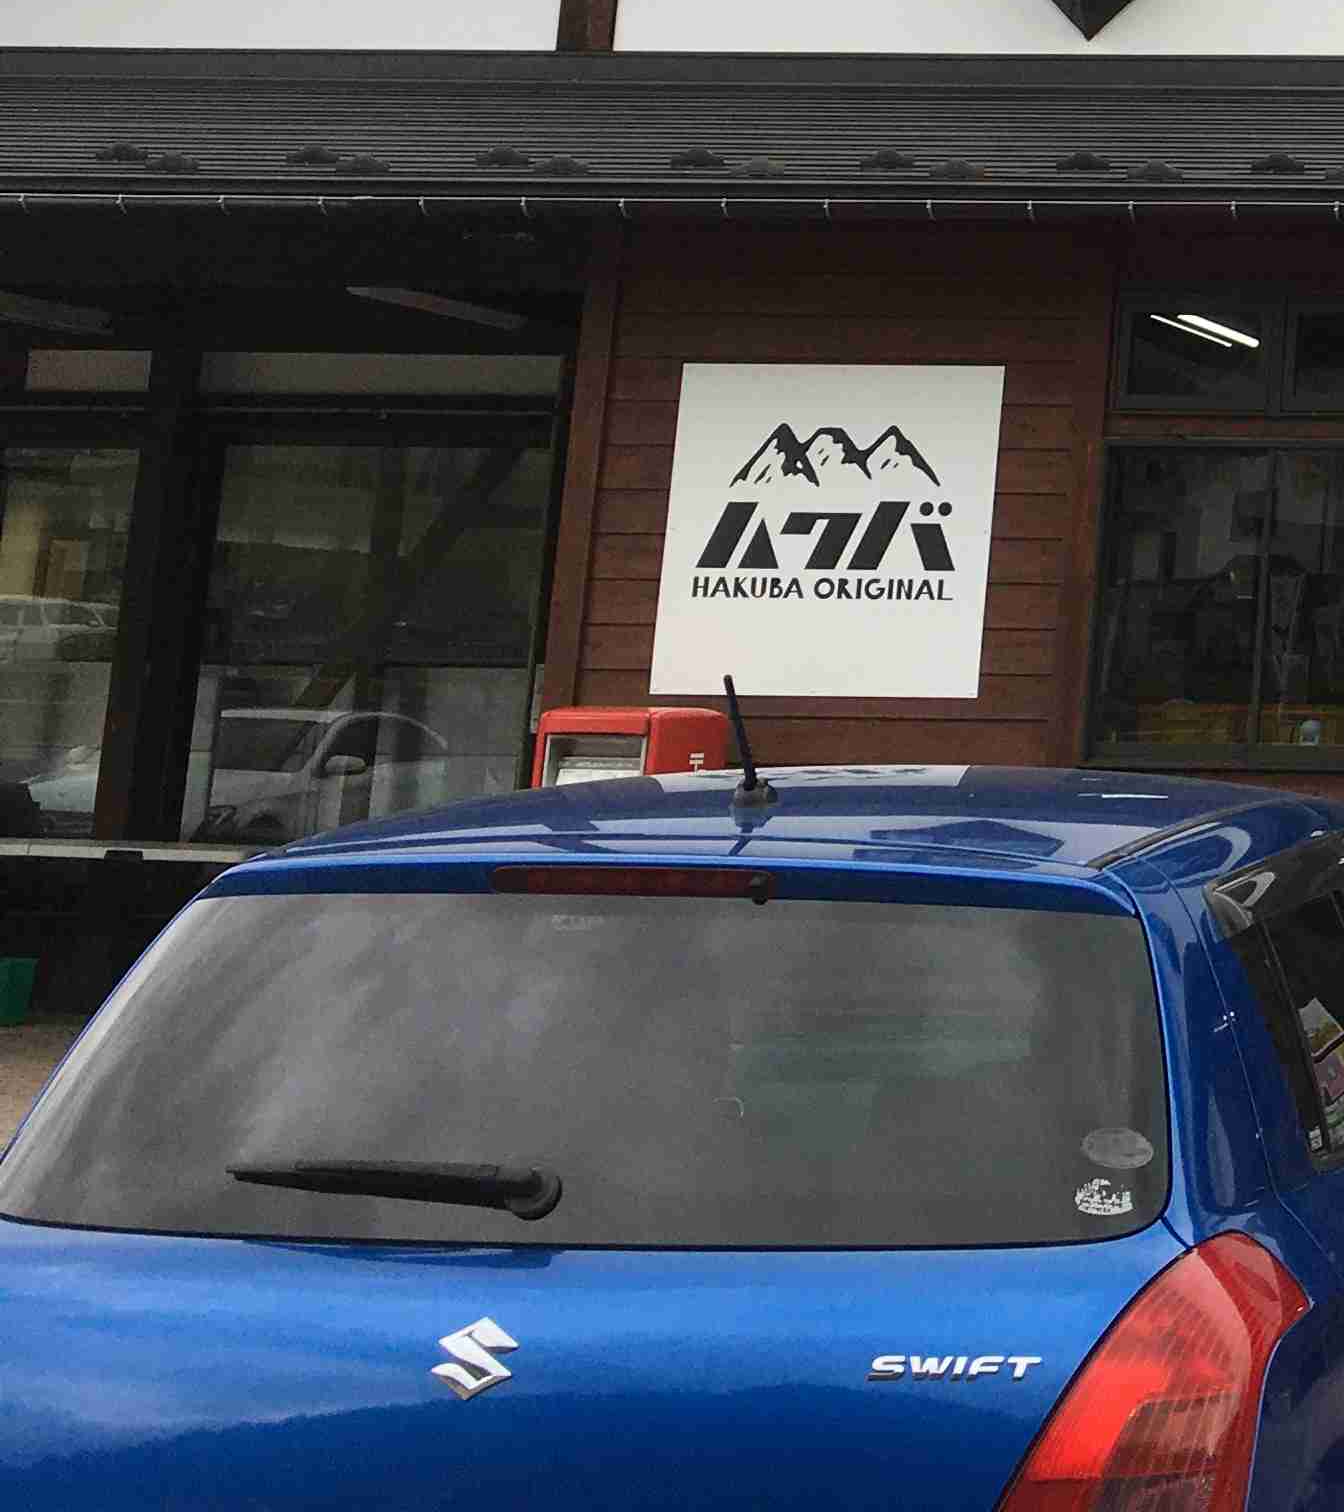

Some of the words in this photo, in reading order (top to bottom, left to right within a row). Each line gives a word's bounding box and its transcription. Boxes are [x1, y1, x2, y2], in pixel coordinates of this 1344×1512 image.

[696, 501, 956, 571] ハクバ
[692, 576, 804, 598] HAKUBA
[813, 578, 954, 600] ORIGINAL
[868, 1355, 1042, 1380] SWIFT
